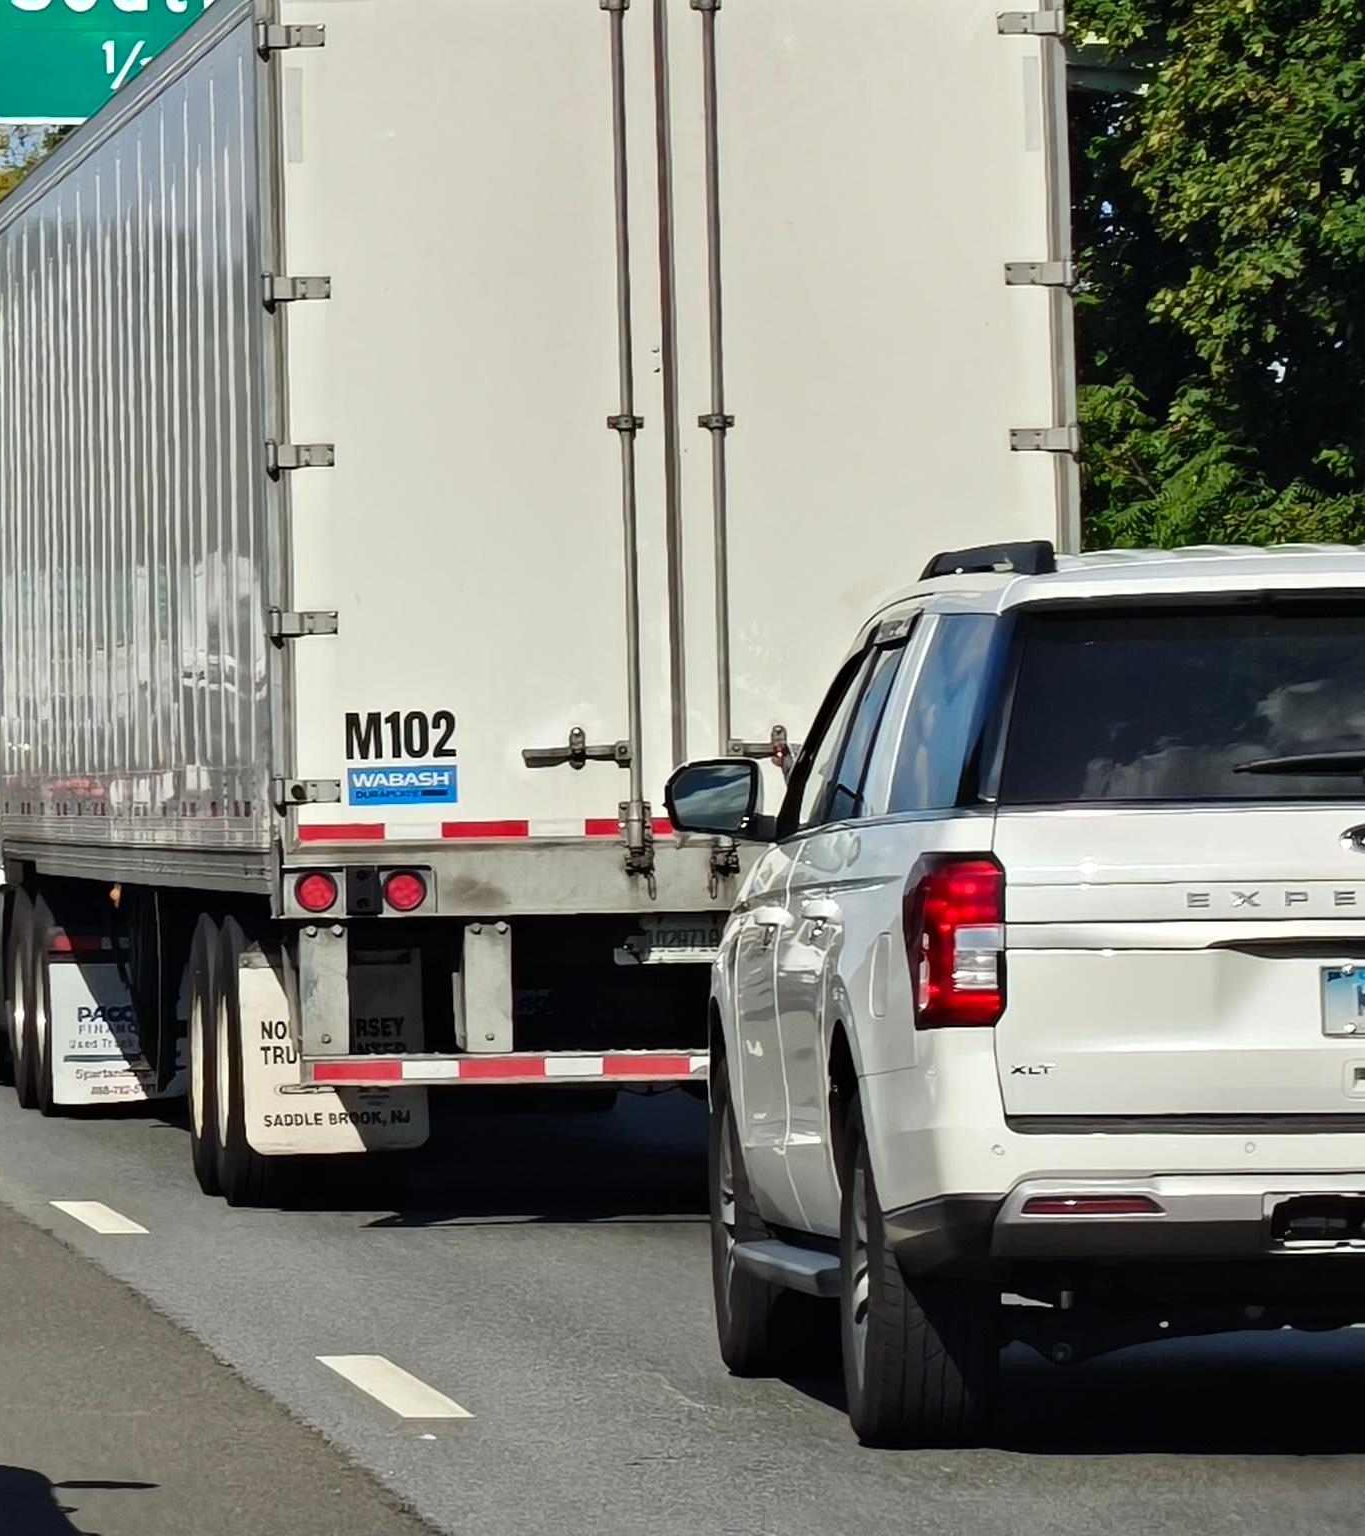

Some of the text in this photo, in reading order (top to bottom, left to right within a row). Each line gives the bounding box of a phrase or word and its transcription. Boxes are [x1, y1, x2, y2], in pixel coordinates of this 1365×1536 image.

[345, 710, 457, 760] M102
[352, 771, 450, 788] WABASH
[1187, 890, 1357, 908] EXPE
[1011, 1064, 1055, 1075] XLT
[264, 1112, 323, 1128] SADDLE
[329, 1111, 387, 1127] BROOK,
